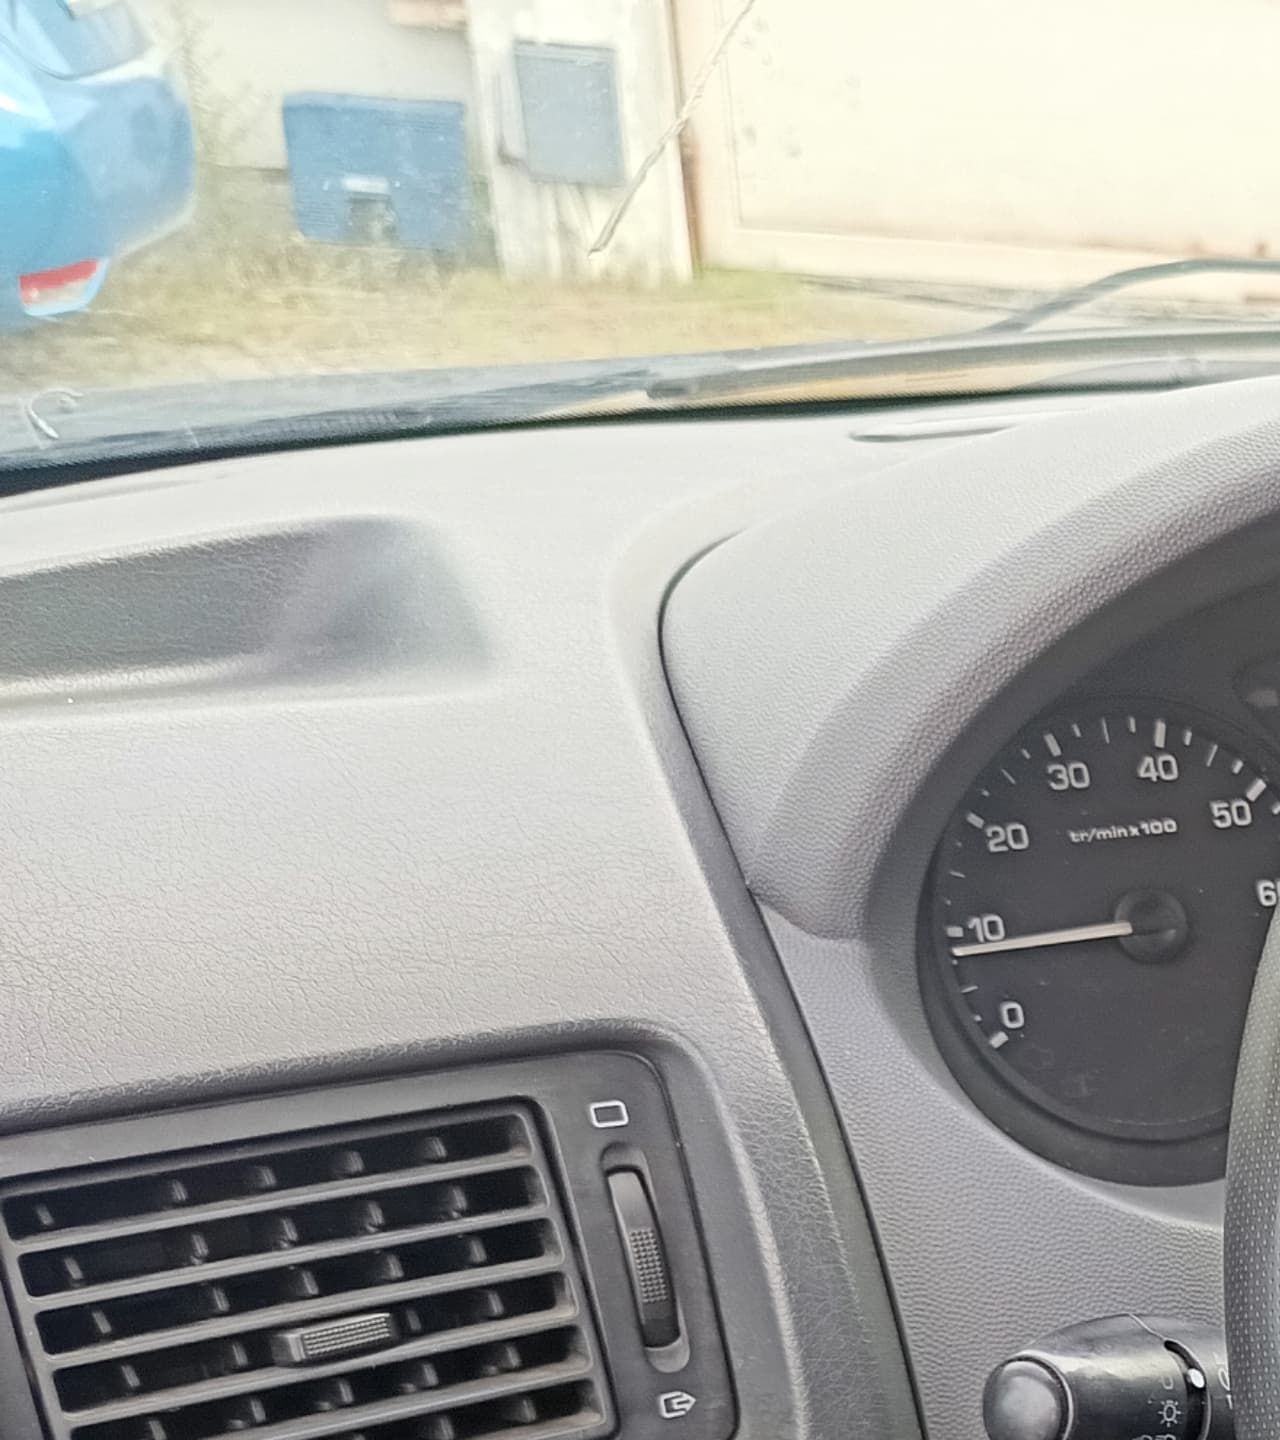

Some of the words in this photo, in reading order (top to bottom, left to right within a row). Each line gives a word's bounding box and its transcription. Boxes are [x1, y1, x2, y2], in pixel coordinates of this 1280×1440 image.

[1047, 762, 1090, 790] 30
[1137, 754, 1179, 782] 40
[1211, 800, 1252, 828] 50
[986, 824, 1029, 851] 20
[968, 914, 1006, 942] 10
[1003, 1002, 1024, 1029] 0
